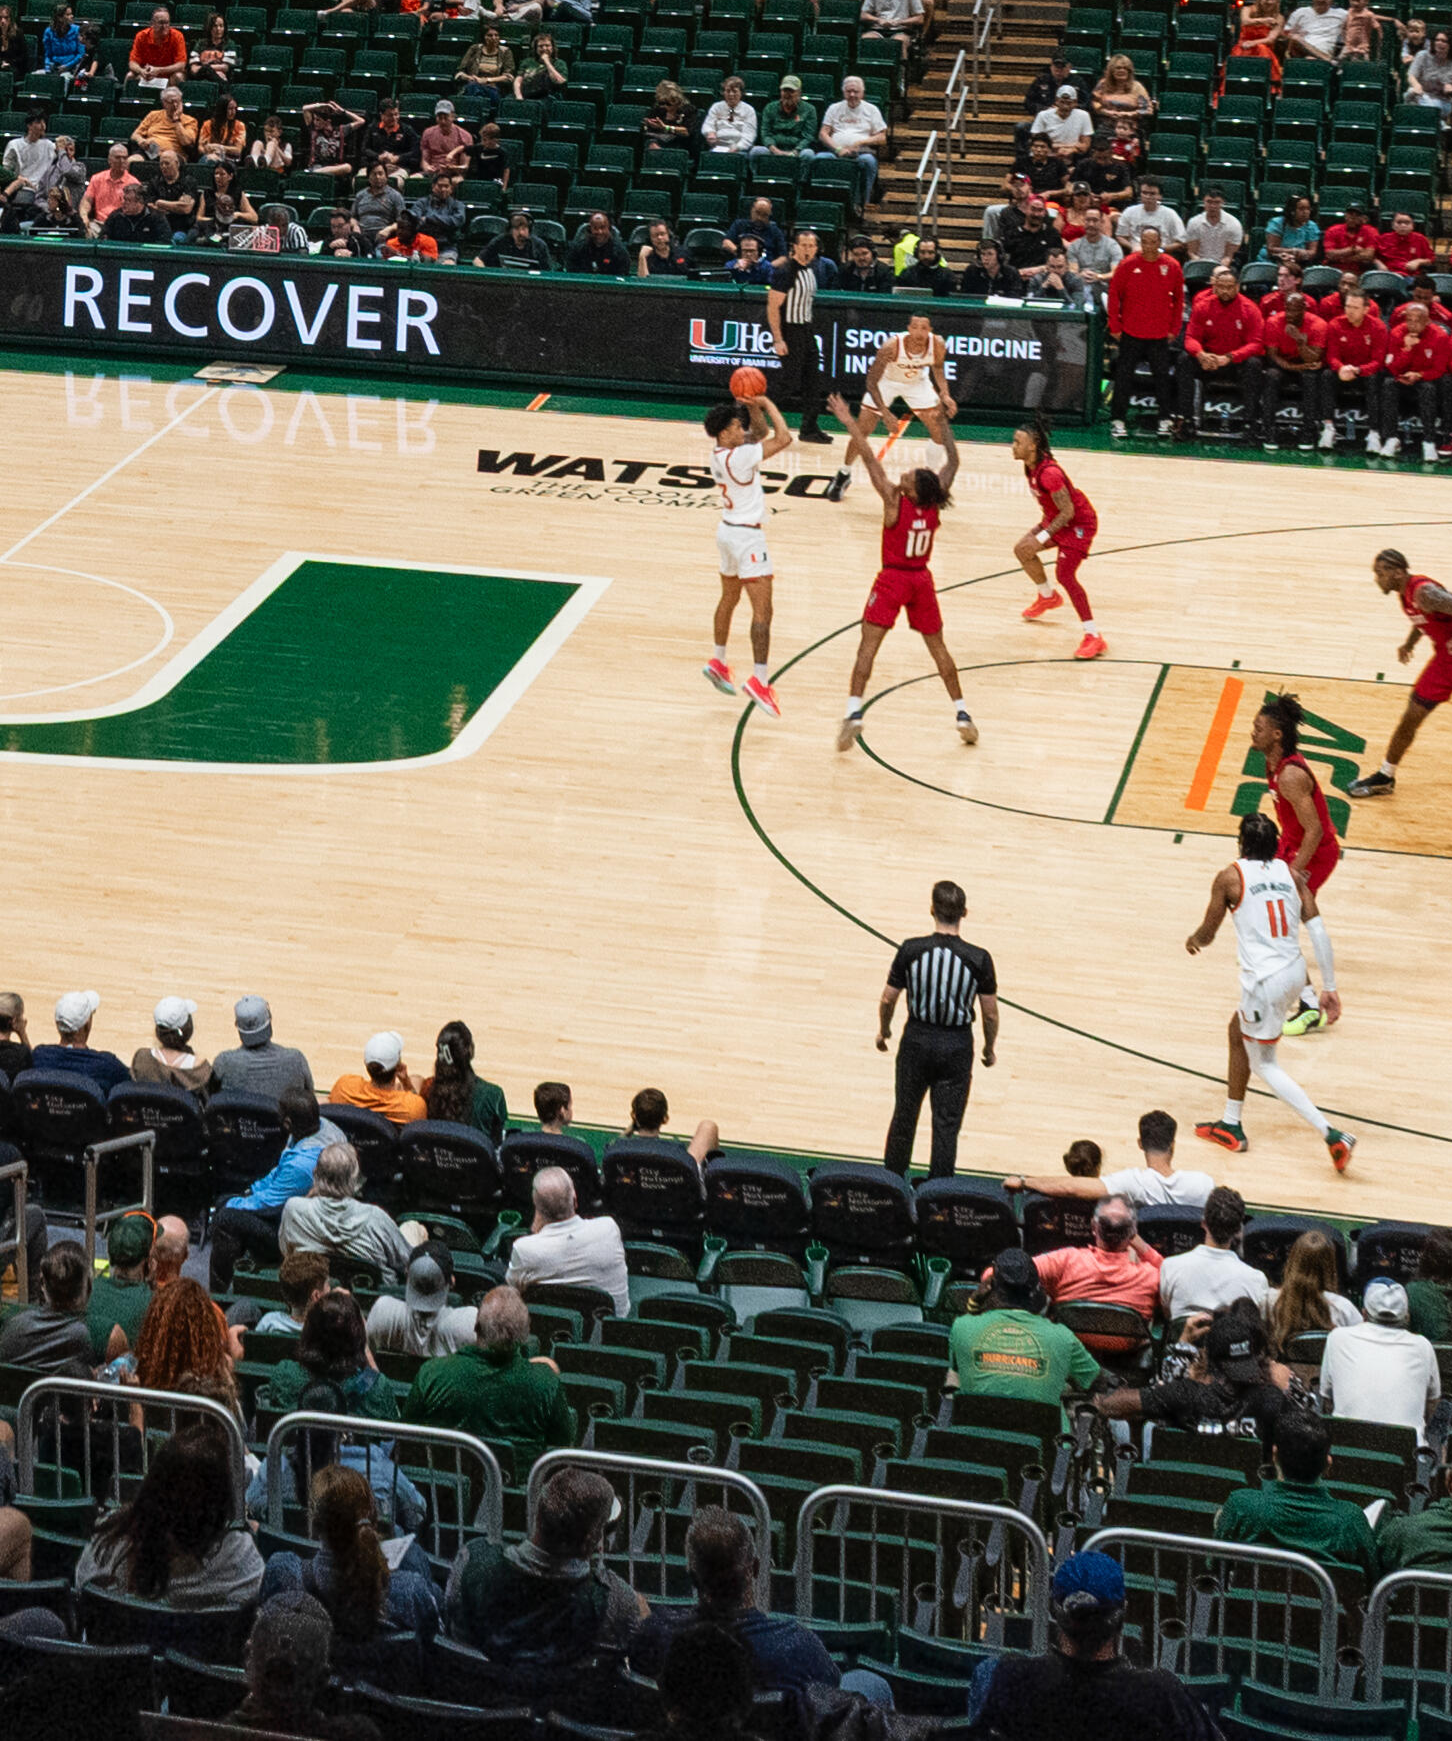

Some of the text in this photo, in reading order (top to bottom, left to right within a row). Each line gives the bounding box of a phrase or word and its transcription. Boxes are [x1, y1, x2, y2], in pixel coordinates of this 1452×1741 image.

[64, 264, 441, 357] RECOVER
[490, 485, 602, 501] GREEN
[529, 480, 585, 493] THE
[905, 529, 932, 559] 10
[1265, 899, 1289, 938] 11
[981, 1351, 1039, 1370] HURRICANES
